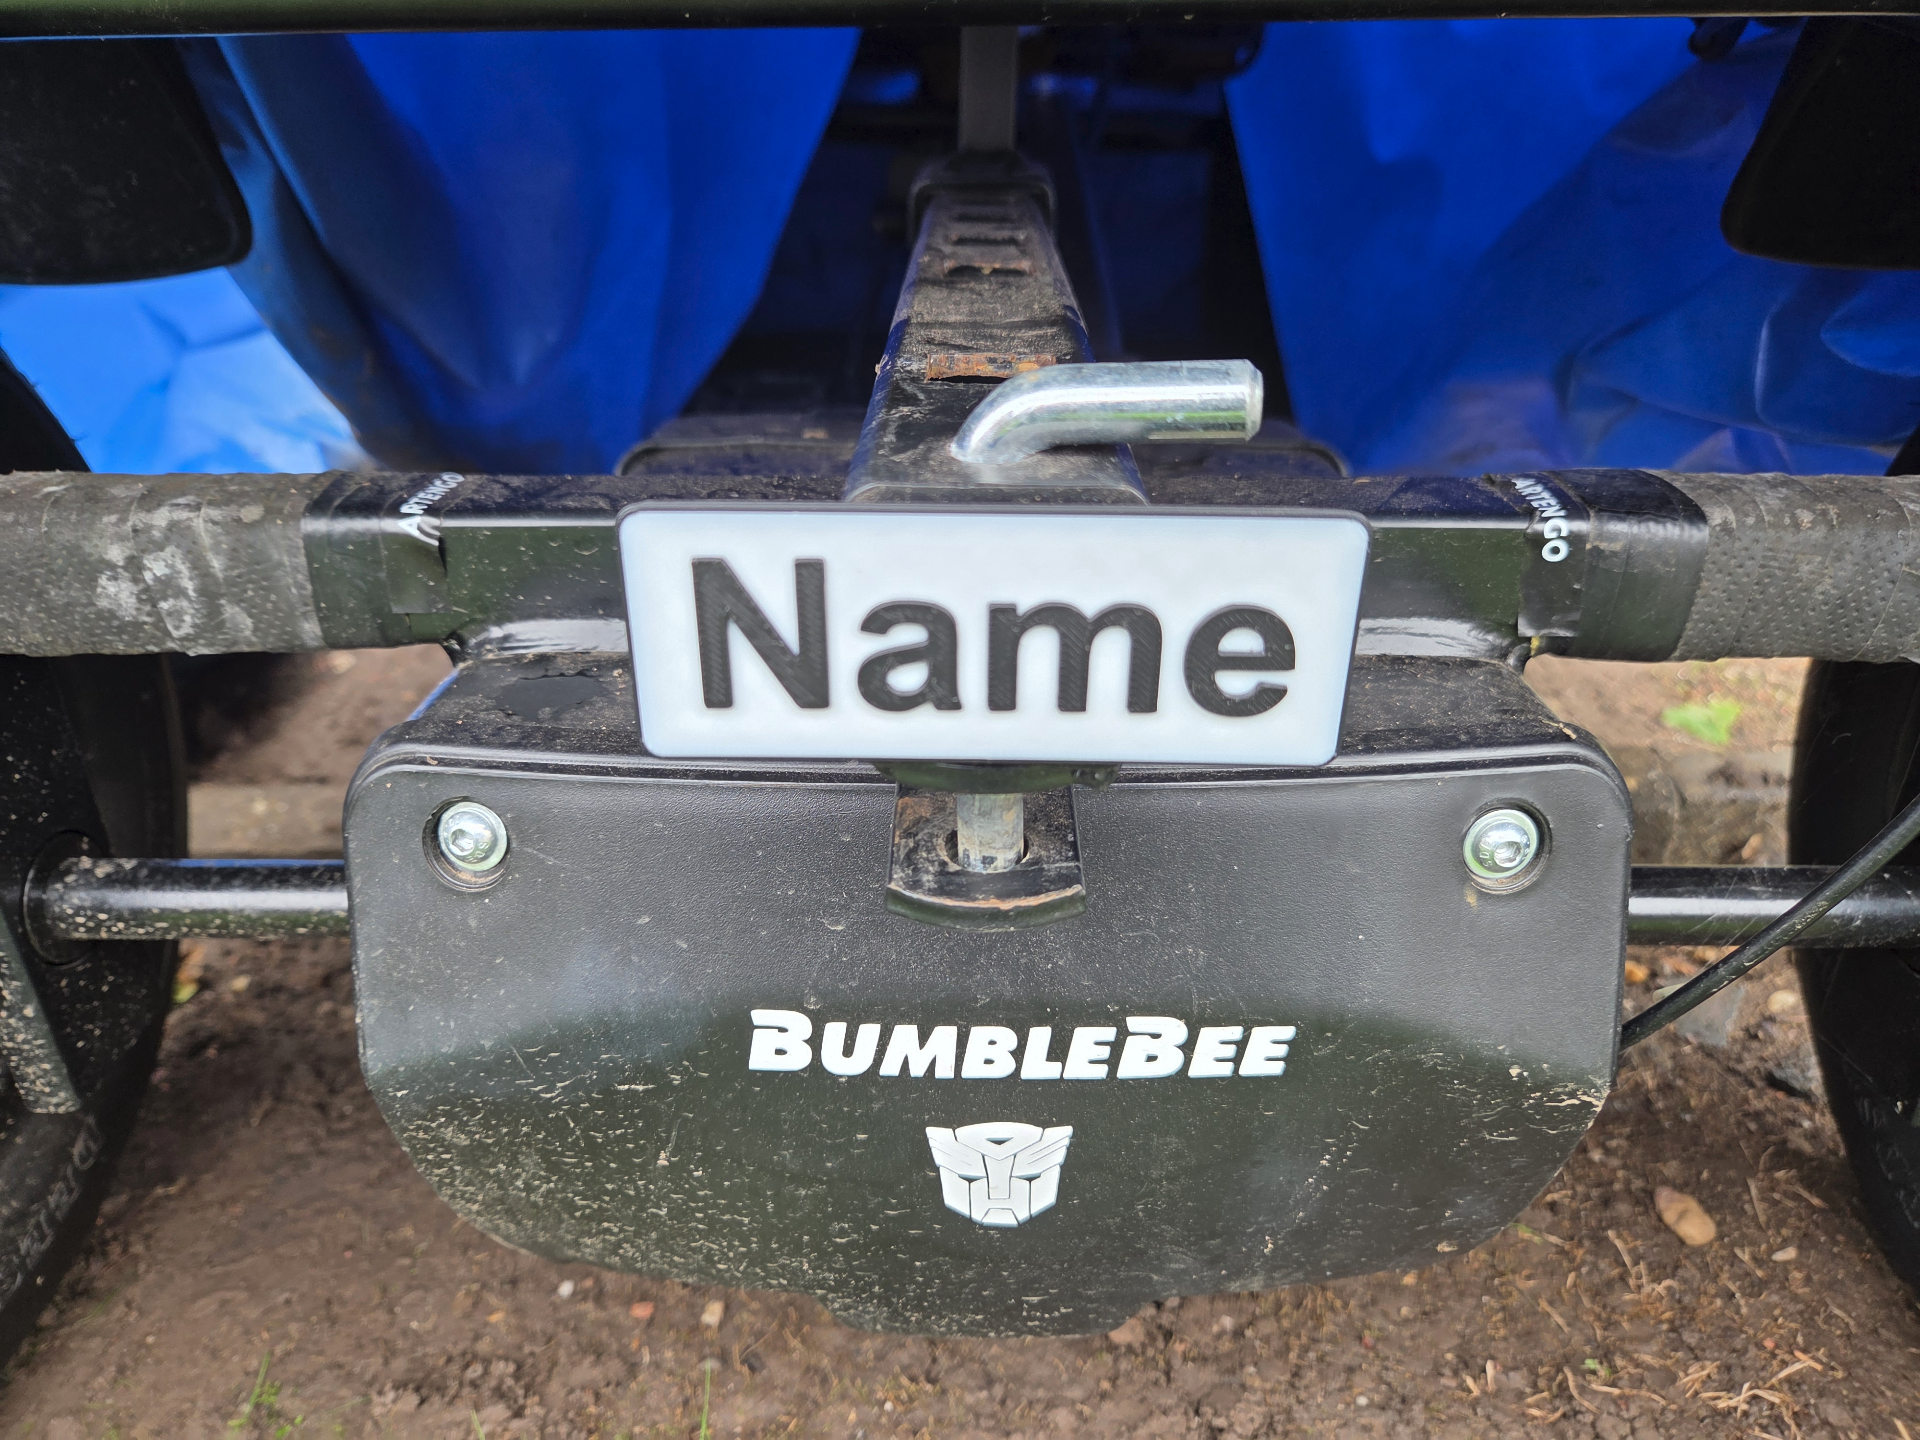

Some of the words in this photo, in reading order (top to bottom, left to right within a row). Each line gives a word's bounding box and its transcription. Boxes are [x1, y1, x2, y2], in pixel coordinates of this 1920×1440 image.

[398, 471, 465, 546] ARTENGO
[1511, 478, 1569, 562] ARTENGO
[692, 557, 1296, 717] Name
